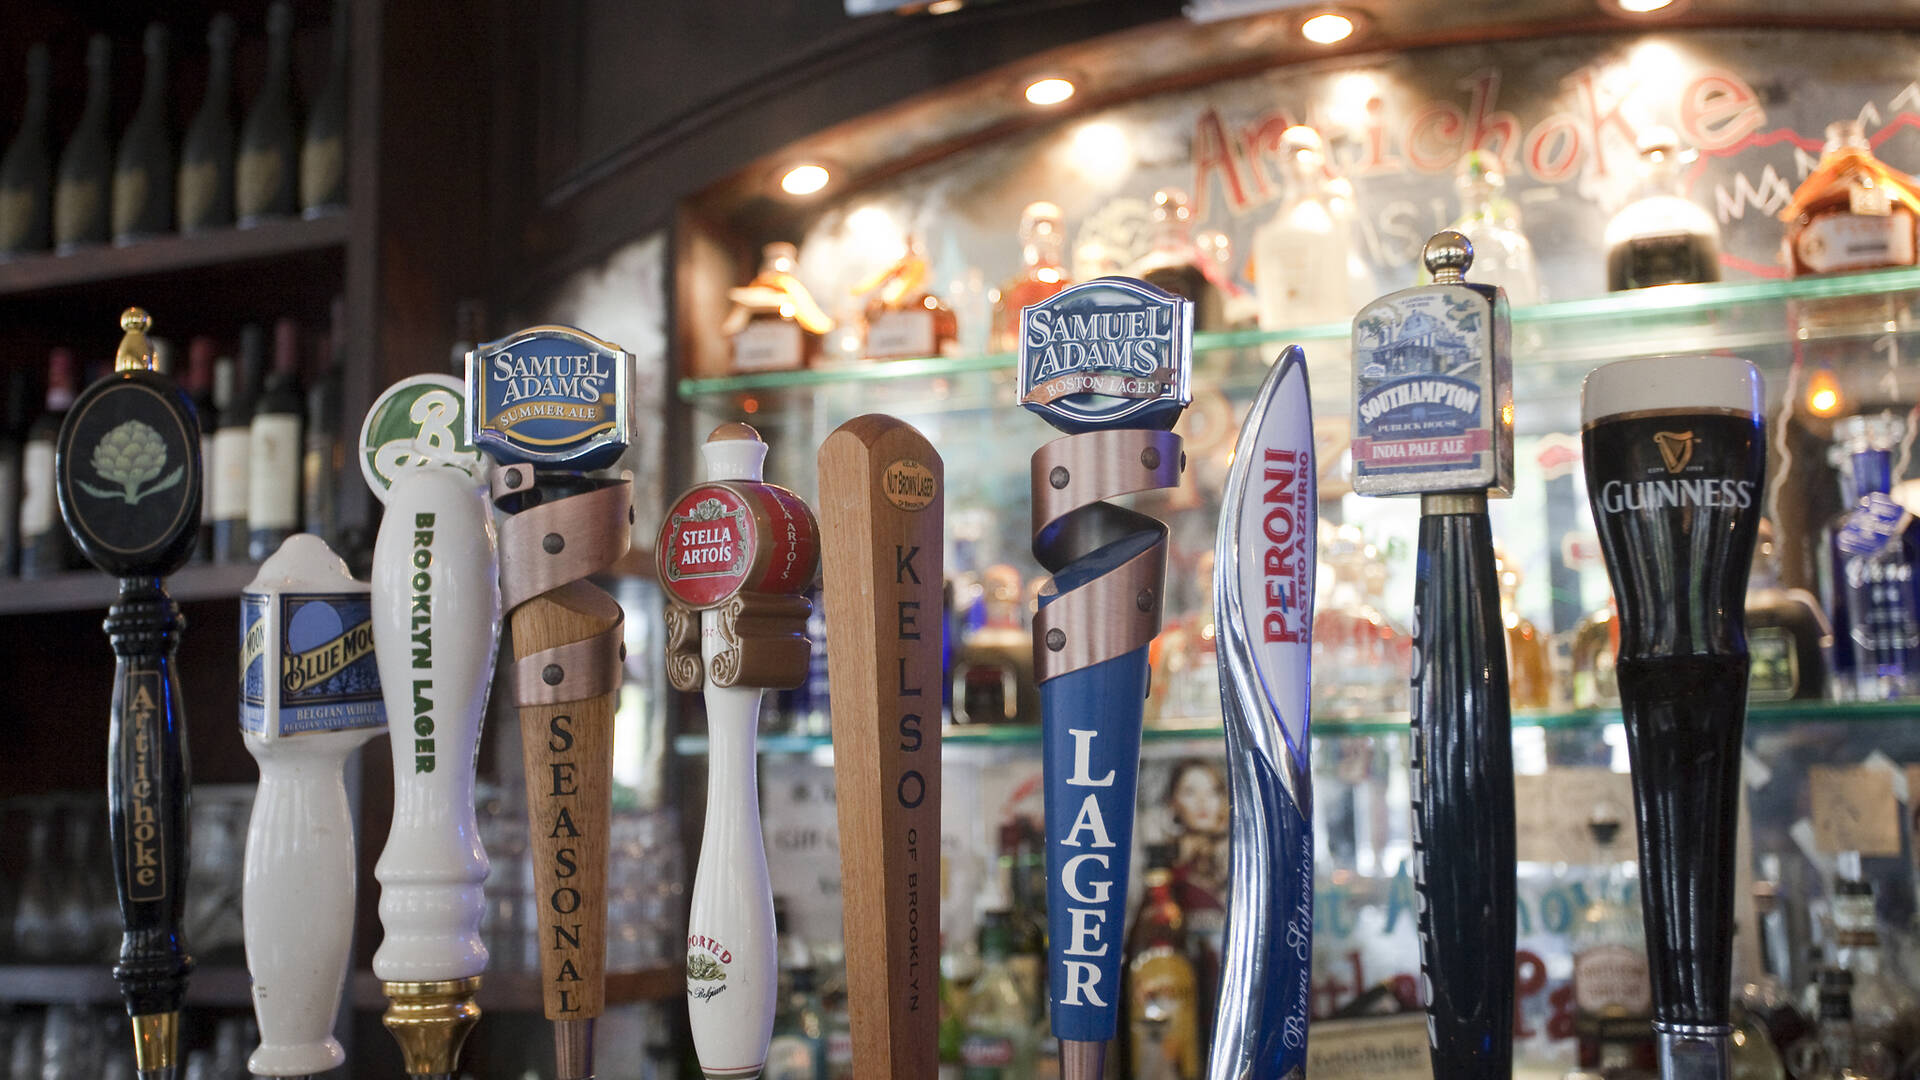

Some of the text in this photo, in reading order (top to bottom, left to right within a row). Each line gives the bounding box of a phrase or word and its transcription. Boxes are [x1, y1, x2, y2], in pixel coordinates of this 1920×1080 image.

[1193, 66, 1768, 220] Arichoke
[1028, 306, 1170, 348] SAMUEL
[493, 352, 609, 381] SAMUEL
[1035, 340, 1159, 380] ADAMS
[501, 376, 600, 407] ADAMS
[1047, 376, 1156, 397] BOSTON LAGER
[1359, 381, 1479, 424] SOUTHAMPTON
[500, 404, 596, 427] SUMMER ALE
[1378, 421, 1458, 433] PUBLICK HOUSE
[1372, 440, 1465, 459] INDIA PALE ALE
[1602, 478, 1751, 513] GUINNESS
[681, 547, 732, 566] ARTOIS
[682, 527, 732, 547] STELLA
[780, 522, 797, 580] ARTOIS
[1262, 448, 1299, 645] PERONI
[1295, 451, 1309, 644] NASTRO AZZURRO
[283, 622, 375, 693] BLUE MOO
[411, 513, 436, 774] BROOKLYN LAGER
[896, 545, 926, 809] KELSO
[297, 703, 377, 721] BELGIAN WHITE
[129, 685, 157, 886] Artichoke
[548, 715, 583, 1014] SEASONAL
[1060, 728, 1116, 1007] LAGER
[907, 828, 920, 1012] OF BROOKLYN
[687, 934, 733, 965] PORTED
[1283, 835, 1313, 1050] Birra Superiore
[694, 983, 727, 1004] Belgium
